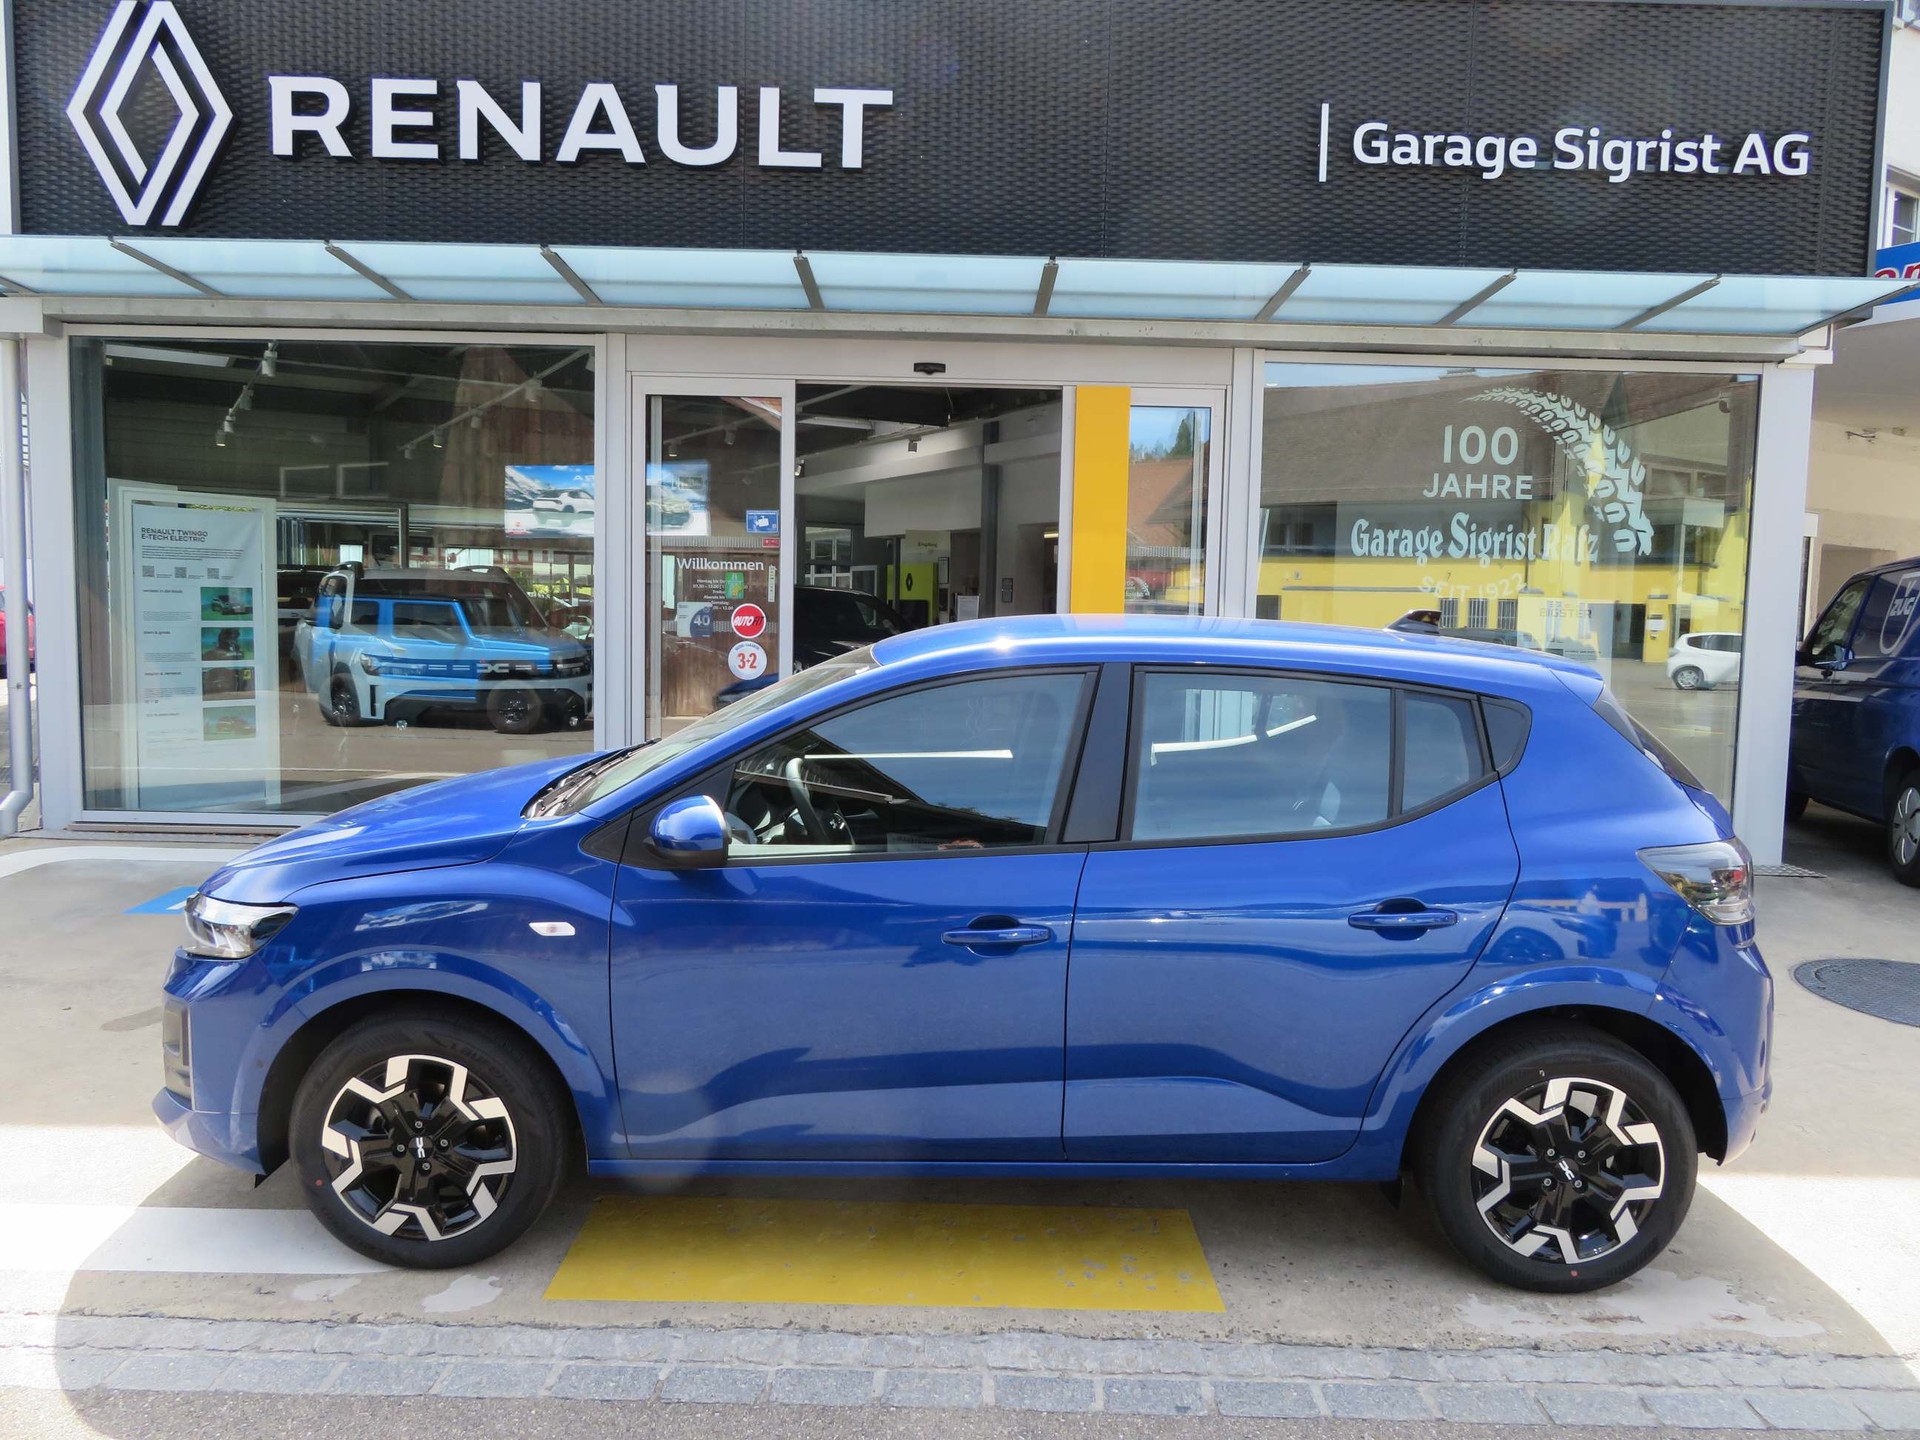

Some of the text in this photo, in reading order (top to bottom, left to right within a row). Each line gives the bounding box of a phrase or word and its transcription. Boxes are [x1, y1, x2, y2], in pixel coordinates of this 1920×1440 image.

[268, 75, 893, 169] RENAULT
[1353, 122, 1809, 183] Garage Sigrist AG
[1443, 425, 1519, 465] 100
[1422, 473, 1534, 500] JAHRE
[141, 527, 208, 537] RENAULT TWINGO
[170, 535, 206, 543] ELECTRIC
[1351, 511, 1599, 568] Garage Sigrist Rafz
[676, 557, 764, 571] Willkommen
[1419, 573, 1527, 600] SEIT 1922
[1889, 597, 1915, 617] ZUG
[693, 615, 710, 626] 40
[737, 652, 757, 669] 3+2
